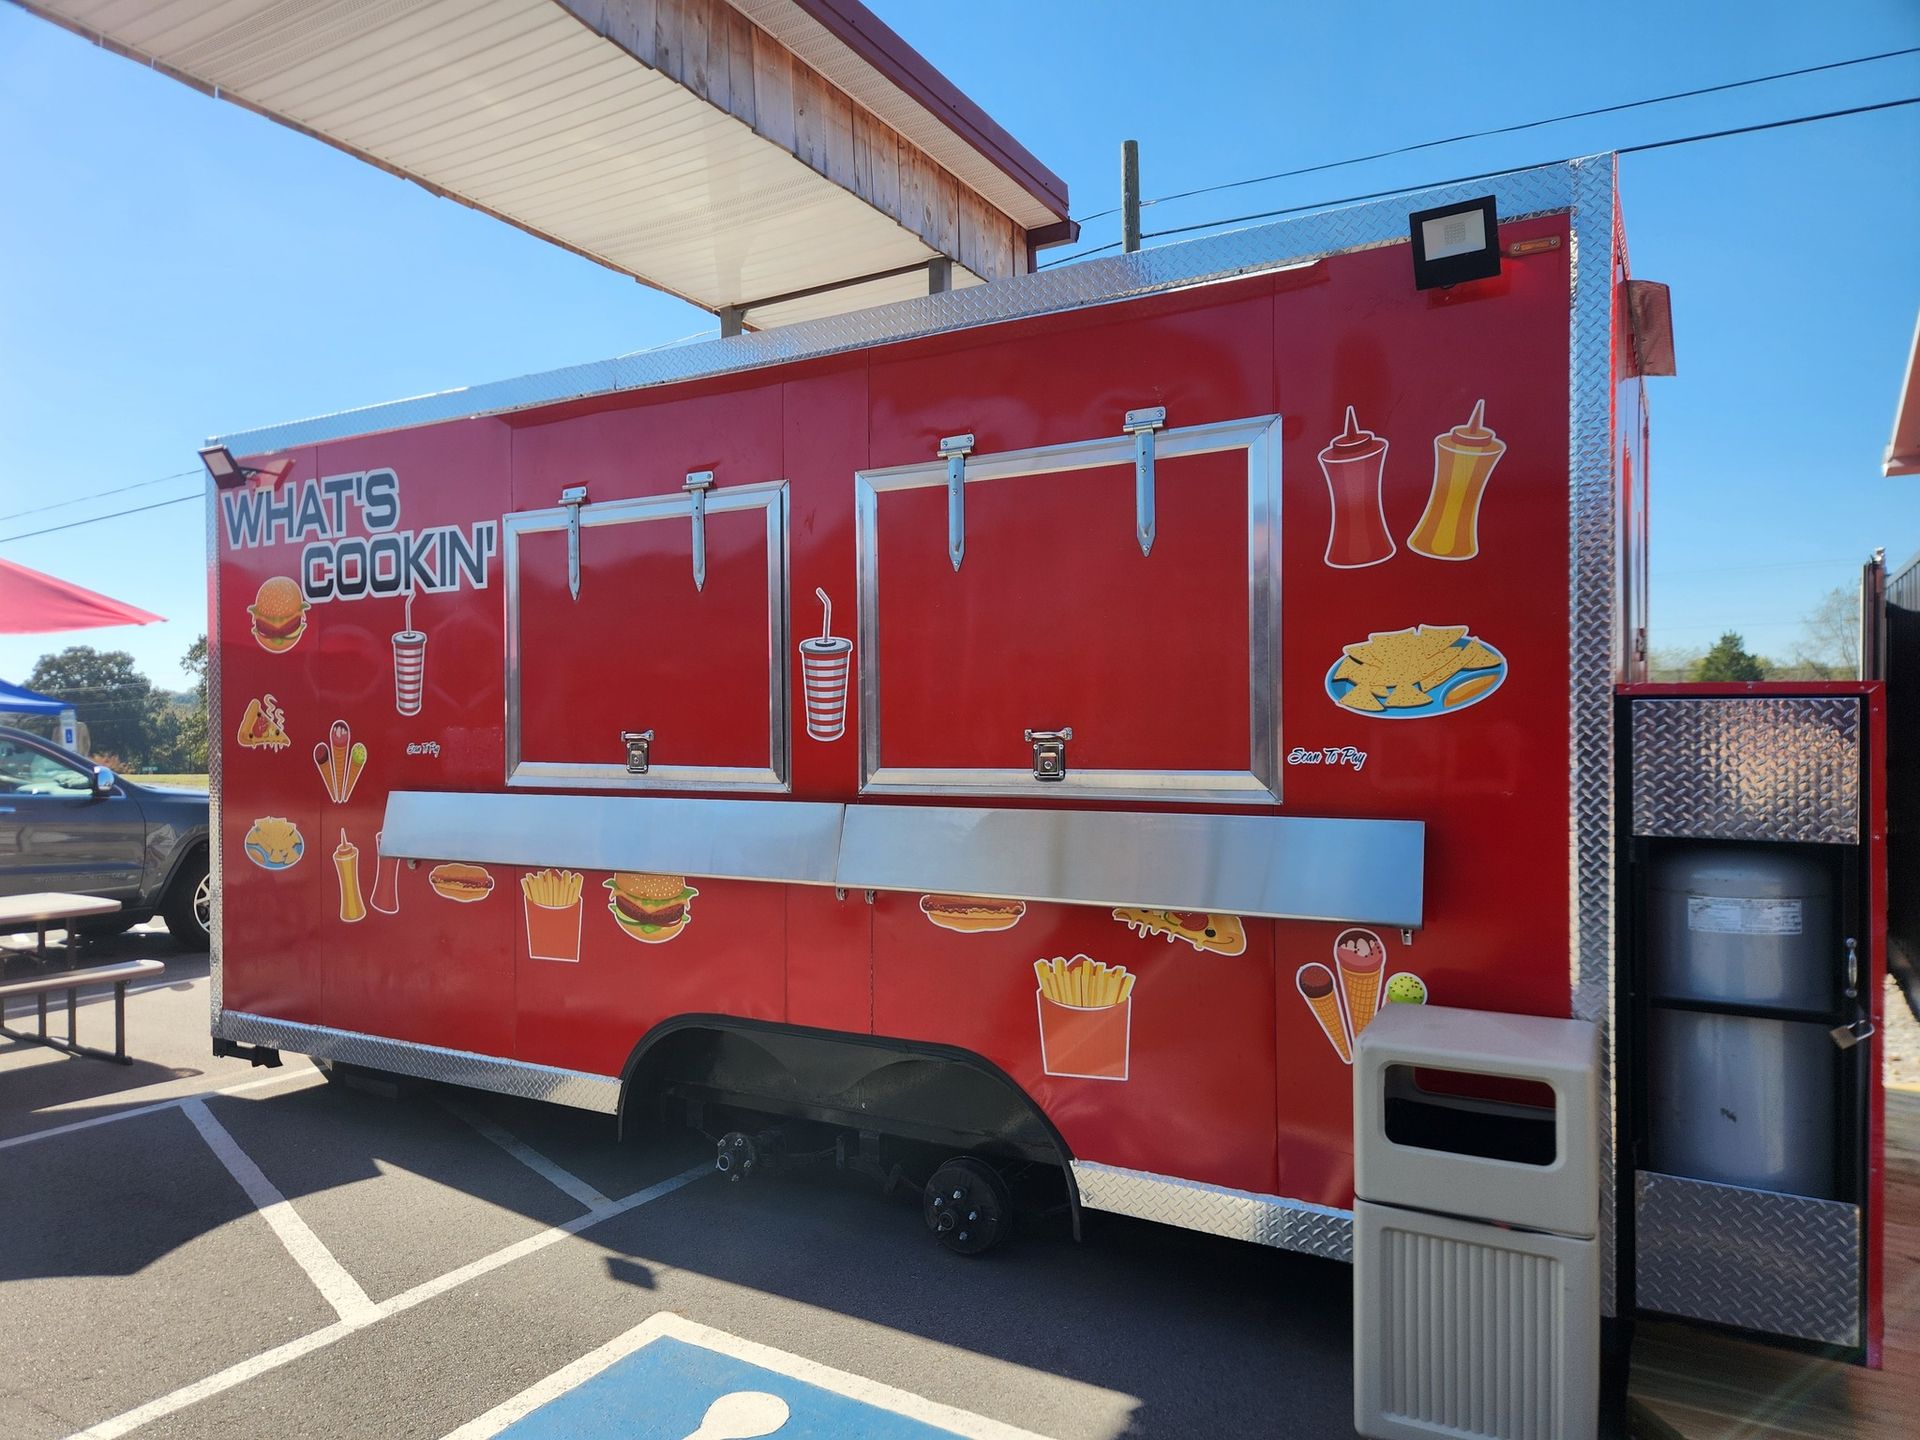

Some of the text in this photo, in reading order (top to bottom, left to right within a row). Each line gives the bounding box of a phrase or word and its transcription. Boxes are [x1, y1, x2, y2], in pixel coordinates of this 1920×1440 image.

[222, 468, 399, 549] WHAT'S
[302, 520, 497, 603] COOKIN'
[1288, 746, 1367, 771] Scan To Pay
